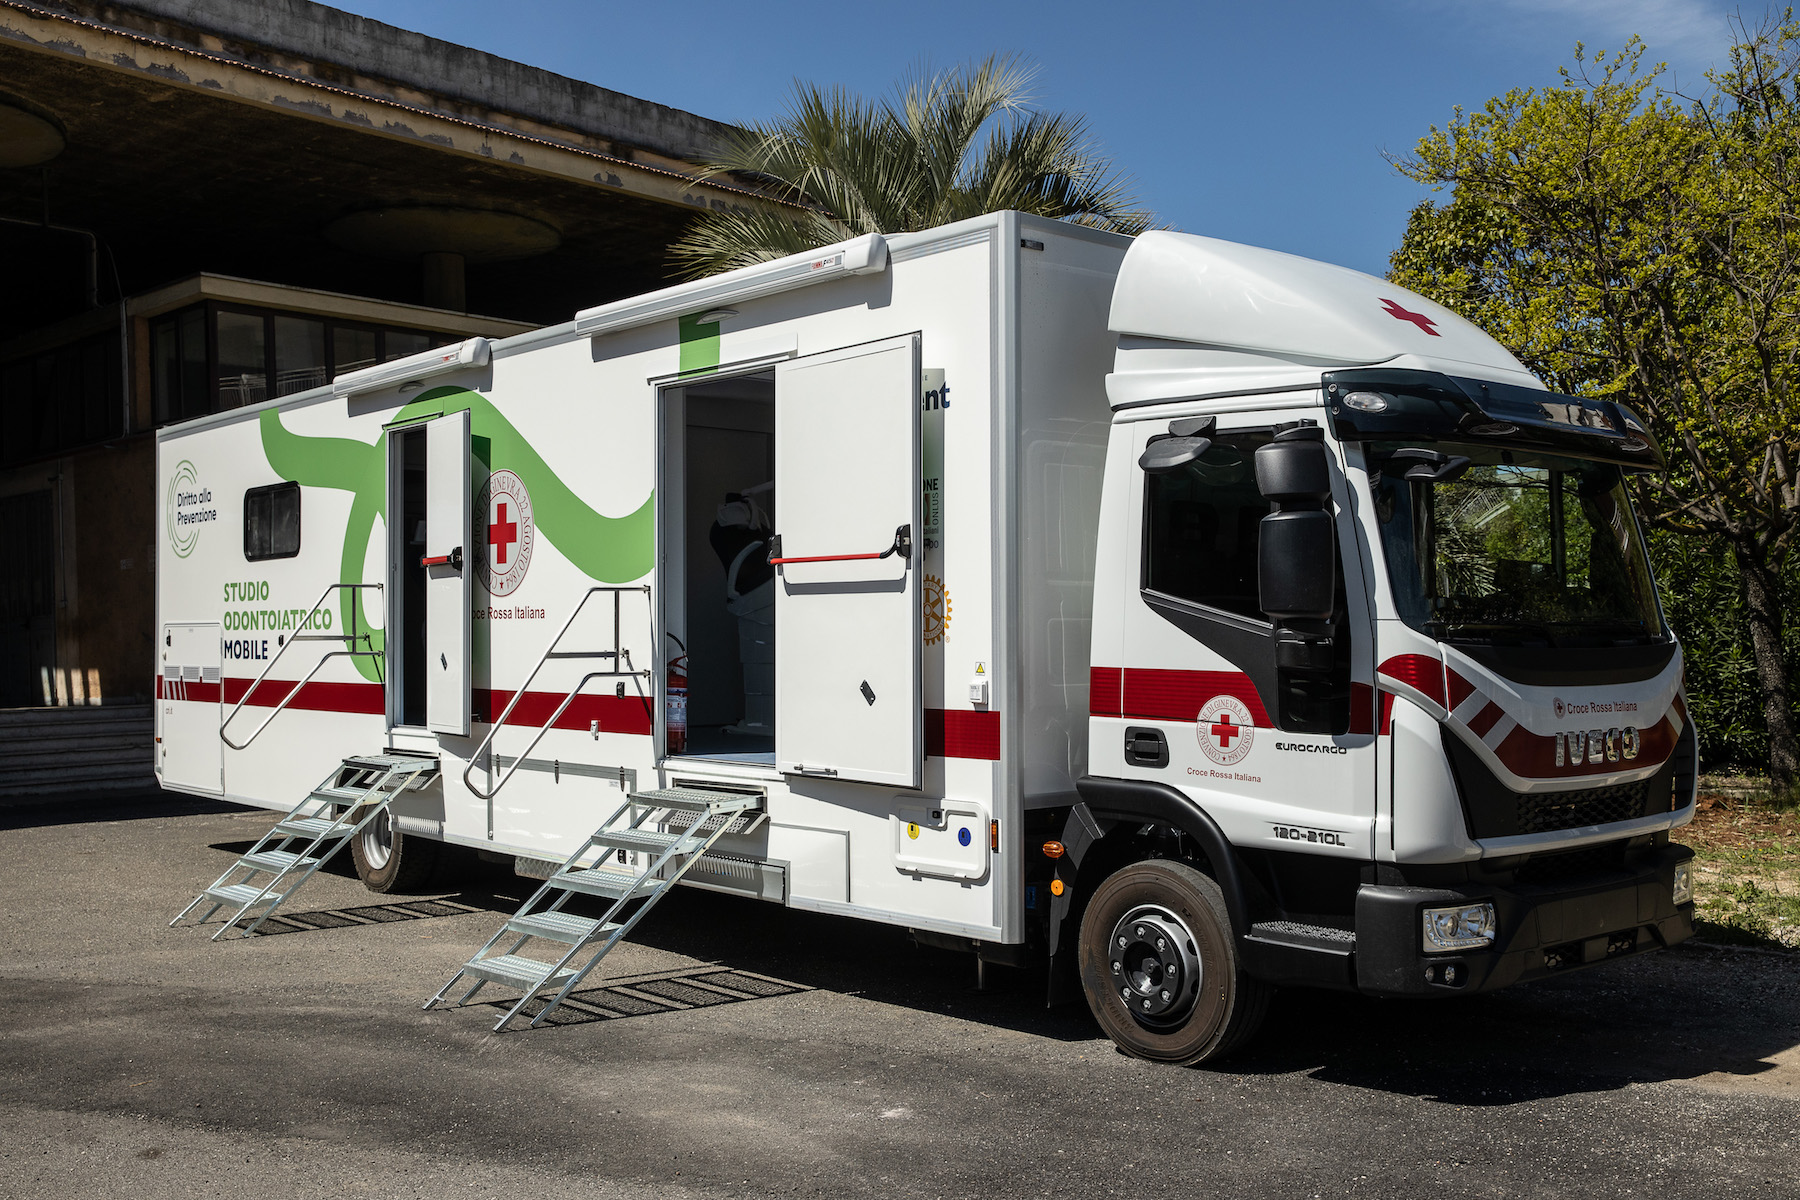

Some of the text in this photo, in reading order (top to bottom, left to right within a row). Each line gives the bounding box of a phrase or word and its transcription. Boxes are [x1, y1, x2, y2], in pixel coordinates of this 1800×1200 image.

[922, 381, 950, 411] nt
[177, 487, 212, 508] Diritto alla
[490, 475, 521, 501] GINEVRA
[519, 495, 529, 513] 22
[932, 492, 940, 526] ONLUS
[177, 507, 217, 526] Prevenzione
[518, 516, 532, 571] AGOSTO
[506, 566, 521, 590] 1864
[223, 580, 270, 603] STUDIO
[223, 608, 333, 631] ODONTOIATRICO
[487, 606, 513, 620] Rossa
[514, 605, 546, 620] Italiana
[223, 639, 269, 660] MOBILE
[1206, 703, 1215, 714] DI
[1213, 699, 1243, 715] GINEVRA
[1241, 712, 1250, 723] 22
[1567, 703, 1590, 714] Croce
[1590, 701, 1613, 713] Rossa
[1613, 700, 1638, 712] Italiana
[1275, 742, 1348, 755] EUROCARGO
[1555, 726, 1640, 767] IVECO
[1186, 766, 1262, 783] Croce Rossa Italiana
[1272, 826, 1346, 847] 120-210L
